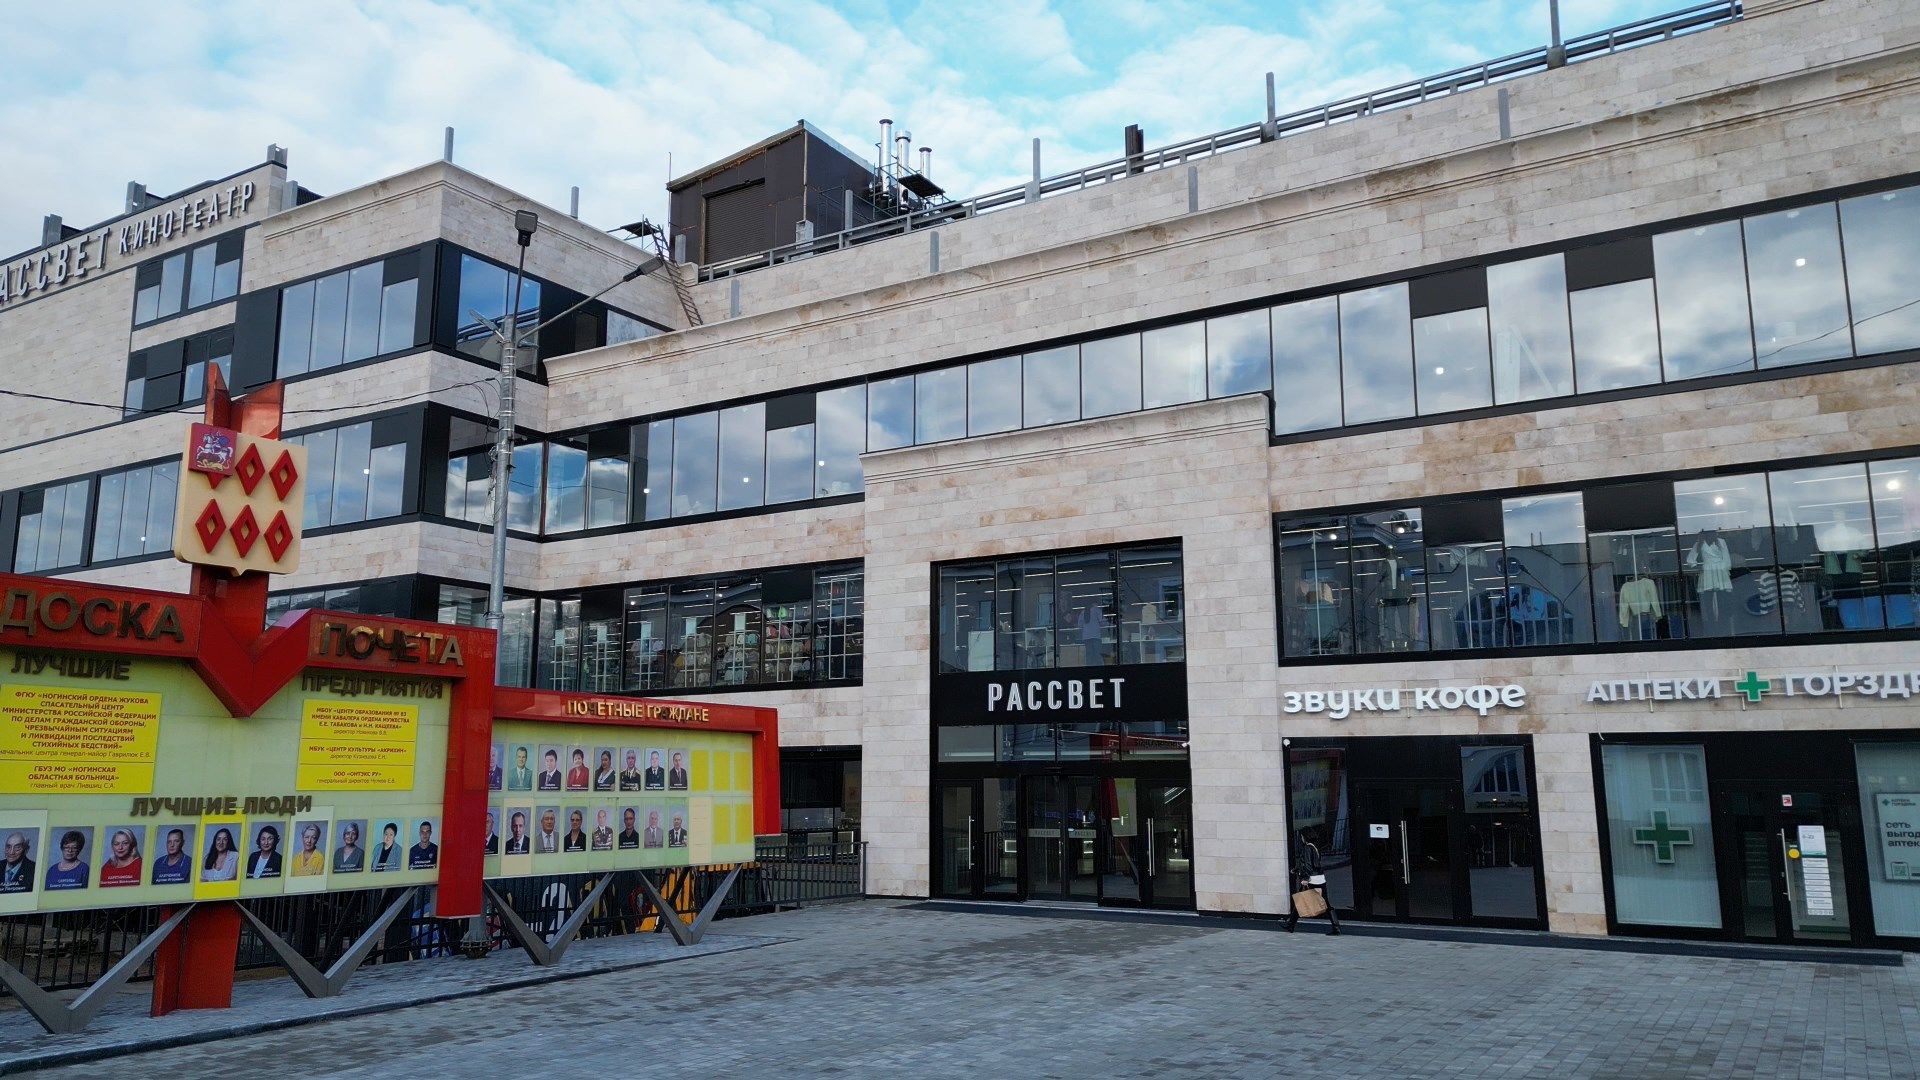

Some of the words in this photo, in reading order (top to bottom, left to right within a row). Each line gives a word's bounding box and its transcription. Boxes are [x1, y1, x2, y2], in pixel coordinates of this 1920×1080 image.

[119, 181, 254, 254] КИНОТЕАТР
[0, 587, 184, 641] ДОСКА
[319, 622, 464, 666] ПОЧЕТА
[11, 652, 131, 680] ЛУЧШИЕ
[37, 692, 88, 701] «НОГИНСКИЙ
[89, 695, 117, 703] ОРДЕНА
[301, 674, 443, 699] ПРЕДПРИЯТИЯ
[988, 678, 1125, 711] РАССВЕТ
[1587, 678, 1721, 701] АПТЕКИ
[40, 700, 100, 710] СПАСАТЕЛЬНЫЙ
[567, 699, 643, 718] ПОЧЕТНЫЕ
[647, 704, 709, 722] ГРАЖДАНЕ
[1283, 688, 1400, 719] звуки
[1415, 684, 1527, 716] кофе
[2, 707, 61, 716] МИНИСТЕРСТВА
[63, 709, 113, 718] РОССИЙСКОЙ
[114, 712, 157, 720] ФЕДЕРАЦИИ
[24, 716, 51, 724] ДЕЛАМ
[52, 717, 108, 726] ГРАЖДАНСКОЙ
[25, 724, 88, 733] ЧРЕЗВЫЧАЙНЫМ
[89, 727, 134, 735] СИТУАЦИЯМ
[28, 732, 81, 741] ЛИКВИДАЦИИ
[82, 734, 135, 742] ПОСЛЕДСТВИЙ
[32, 740, 79, 749] СТИХИЙНЫХ
[28, 773, 73, 781] ОБЛАСТНАЯ
[131, 796, 238, 816] ЛУЧШИЕ
[242, 795, 312, 816] ЛЮДИ
